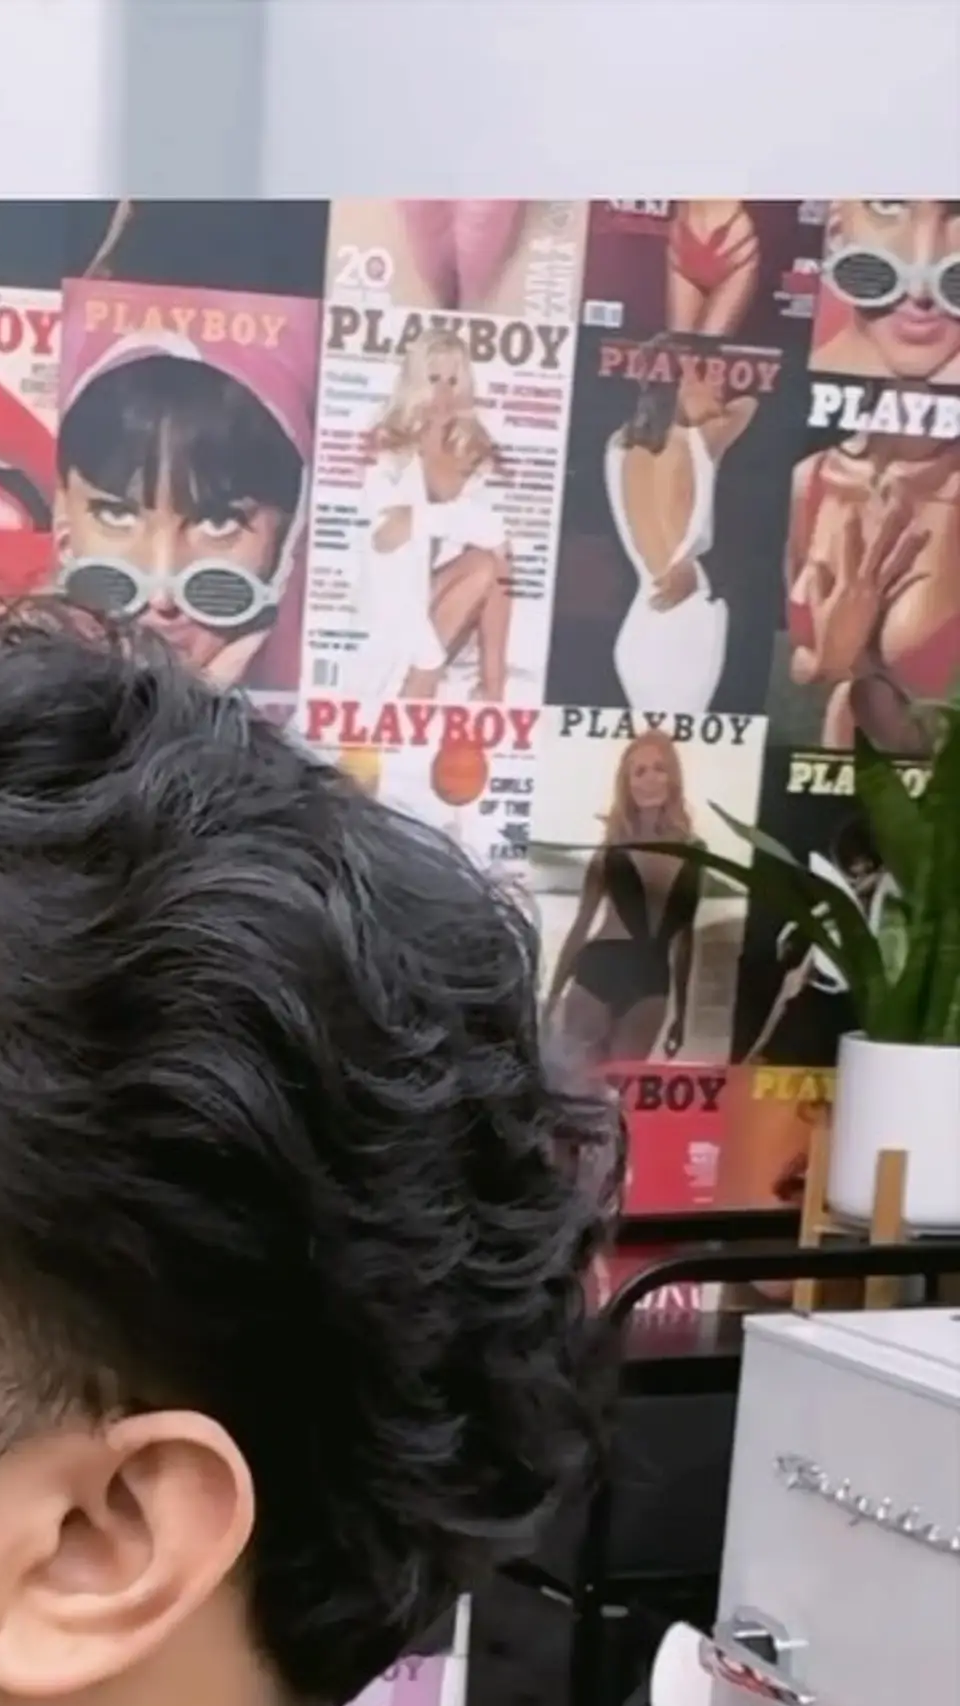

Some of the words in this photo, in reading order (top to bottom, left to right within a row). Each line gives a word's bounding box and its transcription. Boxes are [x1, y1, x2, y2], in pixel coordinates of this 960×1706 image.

[83, 299, 288, 348] PLAYBOY
[597, 347, 782, 392] PLAYBOY
[305, 699, 541, 751] PLAYBOY
[559, 707, 752, 745] PLAYBOY
[786, 761, 933, 799] PLAO
